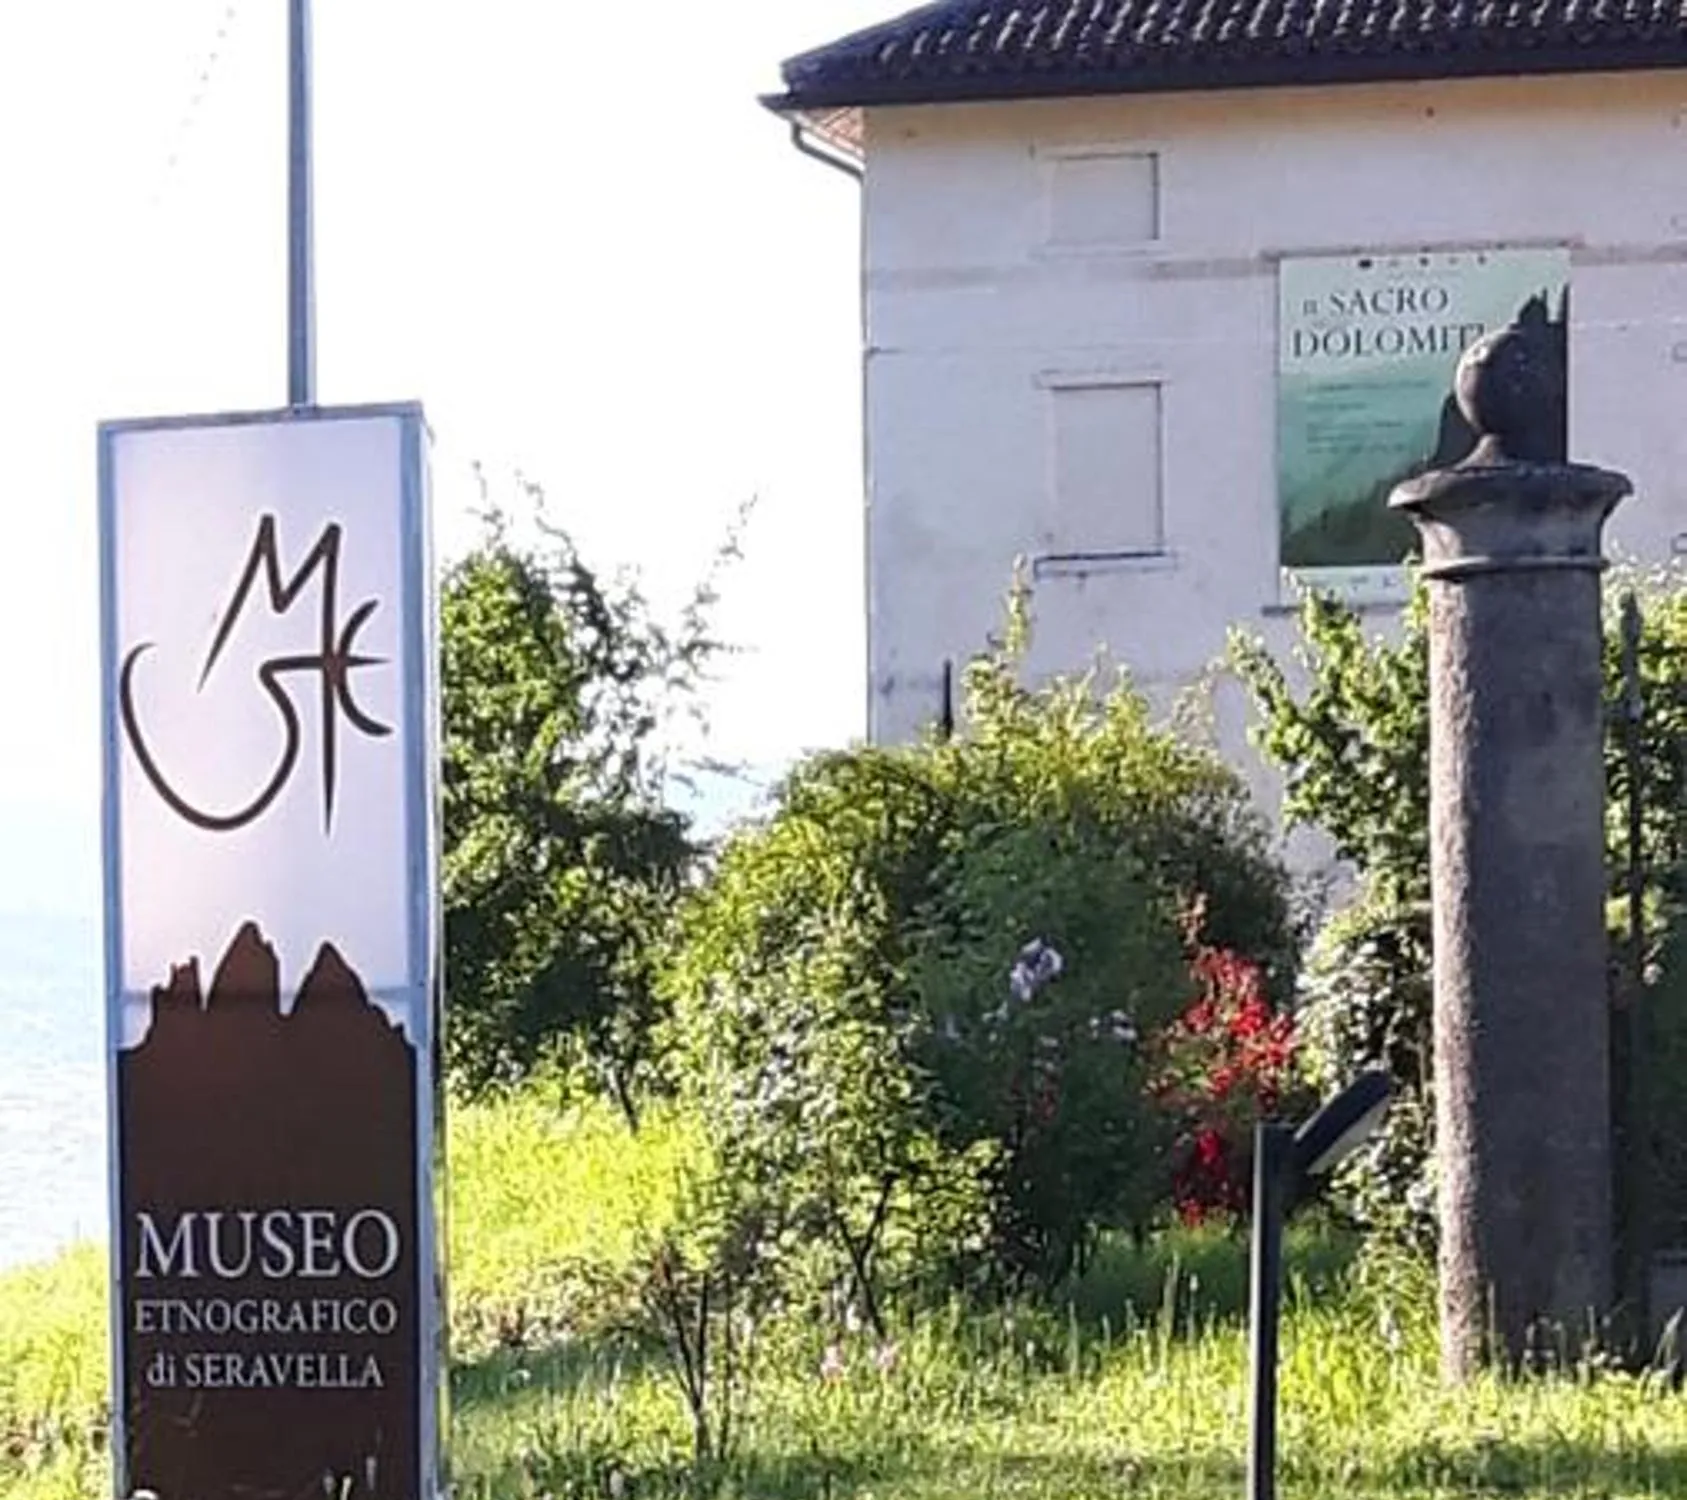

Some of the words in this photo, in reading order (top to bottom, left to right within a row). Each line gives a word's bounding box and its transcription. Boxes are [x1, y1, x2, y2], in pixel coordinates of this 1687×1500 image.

[1329, 287, 1449, 316] SACRO
[135, 1209, 399, 1279] MUSEO
[135, 1299, 398, 1334] ETNOGRAFICO
[147, 1352, 175, 1388] di
[185, 1353, 385, 1388] SERAVELLA
